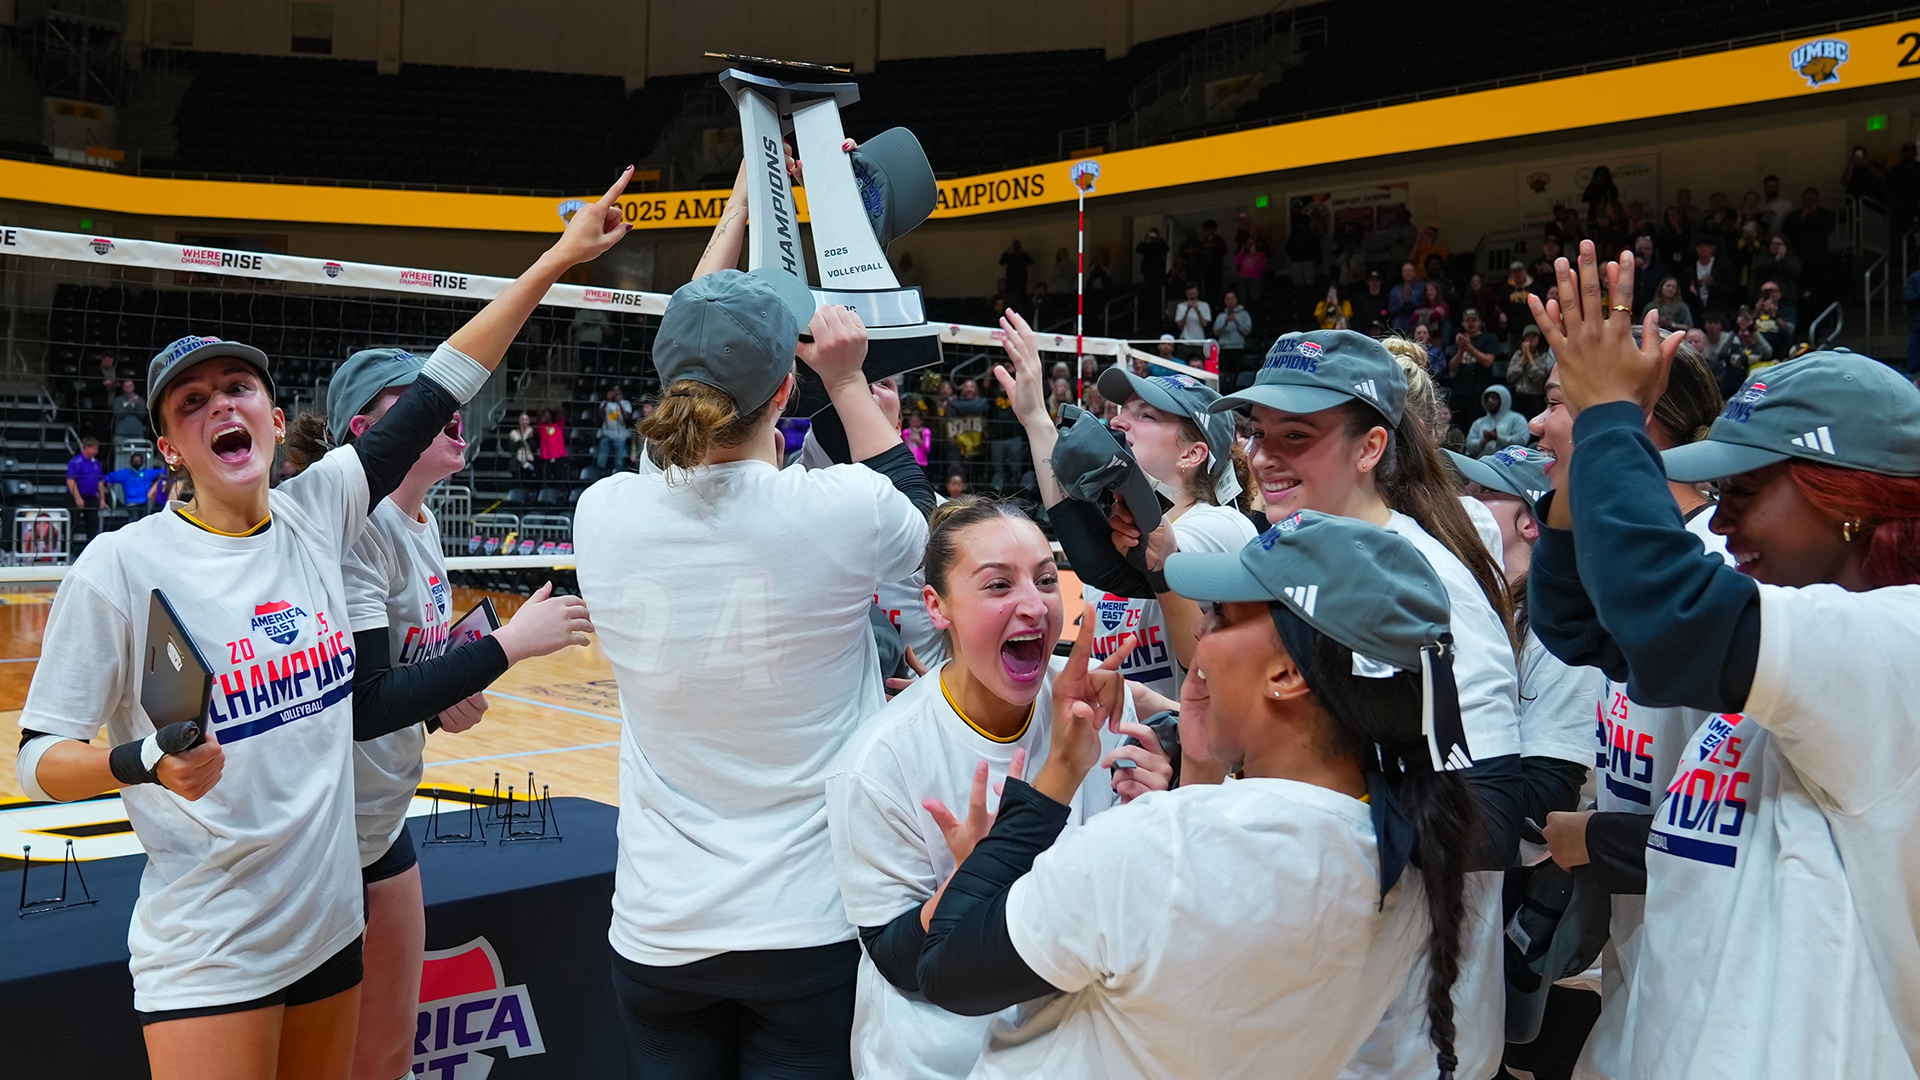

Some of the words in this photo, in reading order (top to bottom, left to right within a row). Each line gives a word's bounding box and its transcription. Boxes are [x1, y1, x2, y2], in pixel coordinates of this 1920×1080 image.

[1792, 41, 1848, 69] UMBC
[1071, 161, 1100, 181] UMBC
[763, 136, 797, 277] HAMPIONS
[183, 249, 221, 261] WHERE
[221, 252, 262, 270] RISE
[824, 247, 848, 258] 2025
[181, 257, 220, 267] CHAMPIONS
[827, 262, 883, 278] VOLLEYBALL
[401, 271, 432, 281] WHERE
[433, 274, 467, 290] RISE
[585, 289, 611, 299] WHERE
[611, 292, 642, 306] RISE
[251, 607, 307, 631] AMERICA
[1101, 611, 1124, 620] EAST
[1126, 609, 1141, 627] 25
[264, 619, 297, 636] EAST
[226, 638, 256, 665] 20
[316, 612, 329, 636] 5
[280, 700, 323, 722] VOLLEYBALL
[1611, 691, 1629, 720] 25
[414, 994, 532, 1056] RICA
